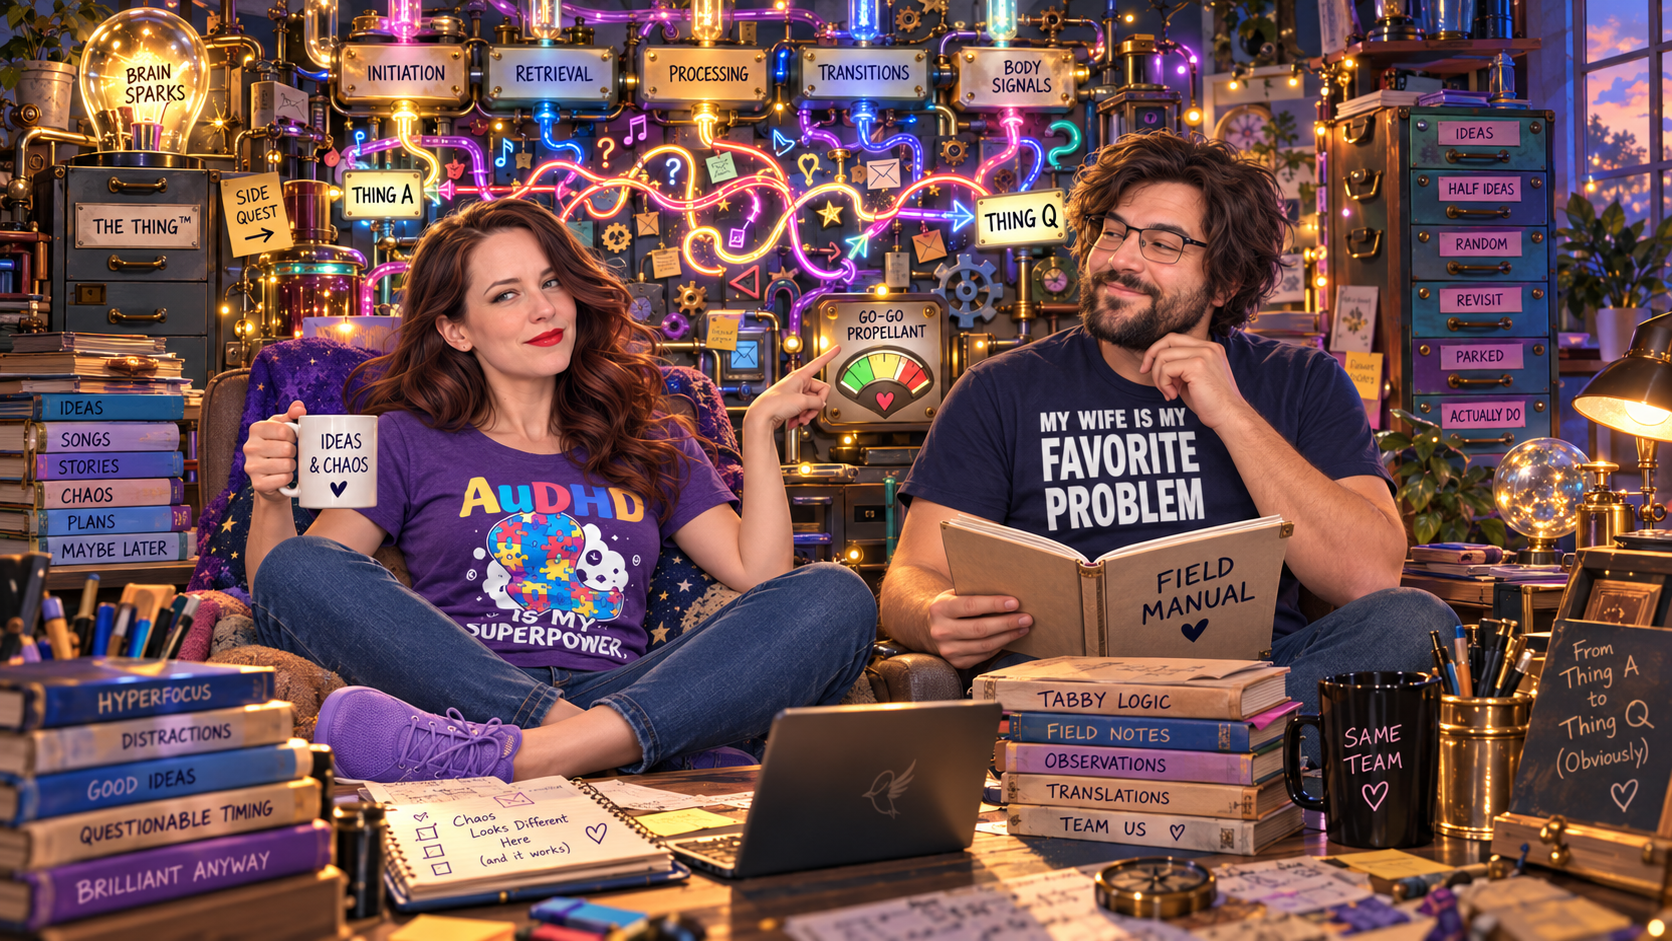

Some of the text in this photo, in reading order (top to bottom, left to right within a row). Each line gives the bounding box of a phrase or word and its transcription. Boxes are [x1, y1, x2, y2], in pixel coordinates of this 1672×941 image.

[126, 63, 171, 84] BRAIN
[368, 64, 445, 81] INITIATION
[516, 65, 593, 83] RETRIEVAL
[669, 64, 749, 83] PROCESSING
[818, 64, 910, 82] TRANSITIONS
[1004, 60, 1042, 75] BODY
[125, 84, 185, 104] SPARKS
[992, 77, 1052, 94] SIGNALS
[1456, 127, 1494, 140] IDEAS
[236, 185, 270, 206] SIDE
[352, 184, 414, 204] THING A
[1448, 182, 1515, 196] HALF IDEAS
[236, 205, 279, 225] QUEST
[985, 203, 1059, 232] THING Q
[93, 218, 124, 235] THE
[1456, 238, 1508, 251] RANDOM
[1457, 293, 1503, 307] REVISIT
[858, 309, 904, 324] GO-GO
[847, 324, 927, 341] PROPELLANT
[1456, 349, 1504, 363] PARKED
[60, 400, 104, 416] IDEAS
[1450, 408, 1521, 423] ACTUALLY DO
[1040, 407, 1186, 432] MY WIFE IS MY
[61, 432, 111, 448] SONGS
[321, 433, 362, 450] IDEAS
[309, 456, 369, 474] & CHAOS
[1041, 431, 1200, 482] FAVORITE
[58, 459, 119, 475] STORIES
[61, 487, 113, 504] CHAOS
[459, 476, 645, 523] AuDHD
[1045, 477, 1205, 531] PROBLEM
[68, 514, 116, 530] PLANS
[61, 540, 168, 559] MAYBE LATER
[1157, 557, 1234, 594] FIELD
[1142, 581, 1256, 625] MANUAL
[512, 609, 596, 632] IS MY
[1572, 639, 1613, 662] From
[1559, 655, 1639, 690] Thing A
[98, 683, 212, 715] HYPERFOCUS
[1037, 690, 1172, 710] TABBY LOGIC
[1587, 691, 1607, 708] to
[1558, 699, 1654, 741] Thing Q
[122, 723, 232, 749] DISTRACTIONS
[1047, 723, 1170, 742] FIELD NOTES
[1344, 724, 1402, 748] SAME
[1045, 752, 1166, 773] OBSERVATIONS
[1343, 752, 1403, 775] TEAM
[1556, 737, 1649, 780] (Obviously)
[87, 768, 196, 801] GOOD IDEAS
[1046, 783, 1170, 805] TRANSLATIONS
[80, 800, 274, 845] QUESTIONABLE TIMING
[453, 811, 496, 827] Chaos
[470, 814, 569, 839] Looks Different
[1060, 816, 1146, 837] TEAM US
[500, 834, 531, 849] Here
[479, 842, 571, 867] (and it works)
[76, 851, 271, 904] BRILLIANT ANYWAY
